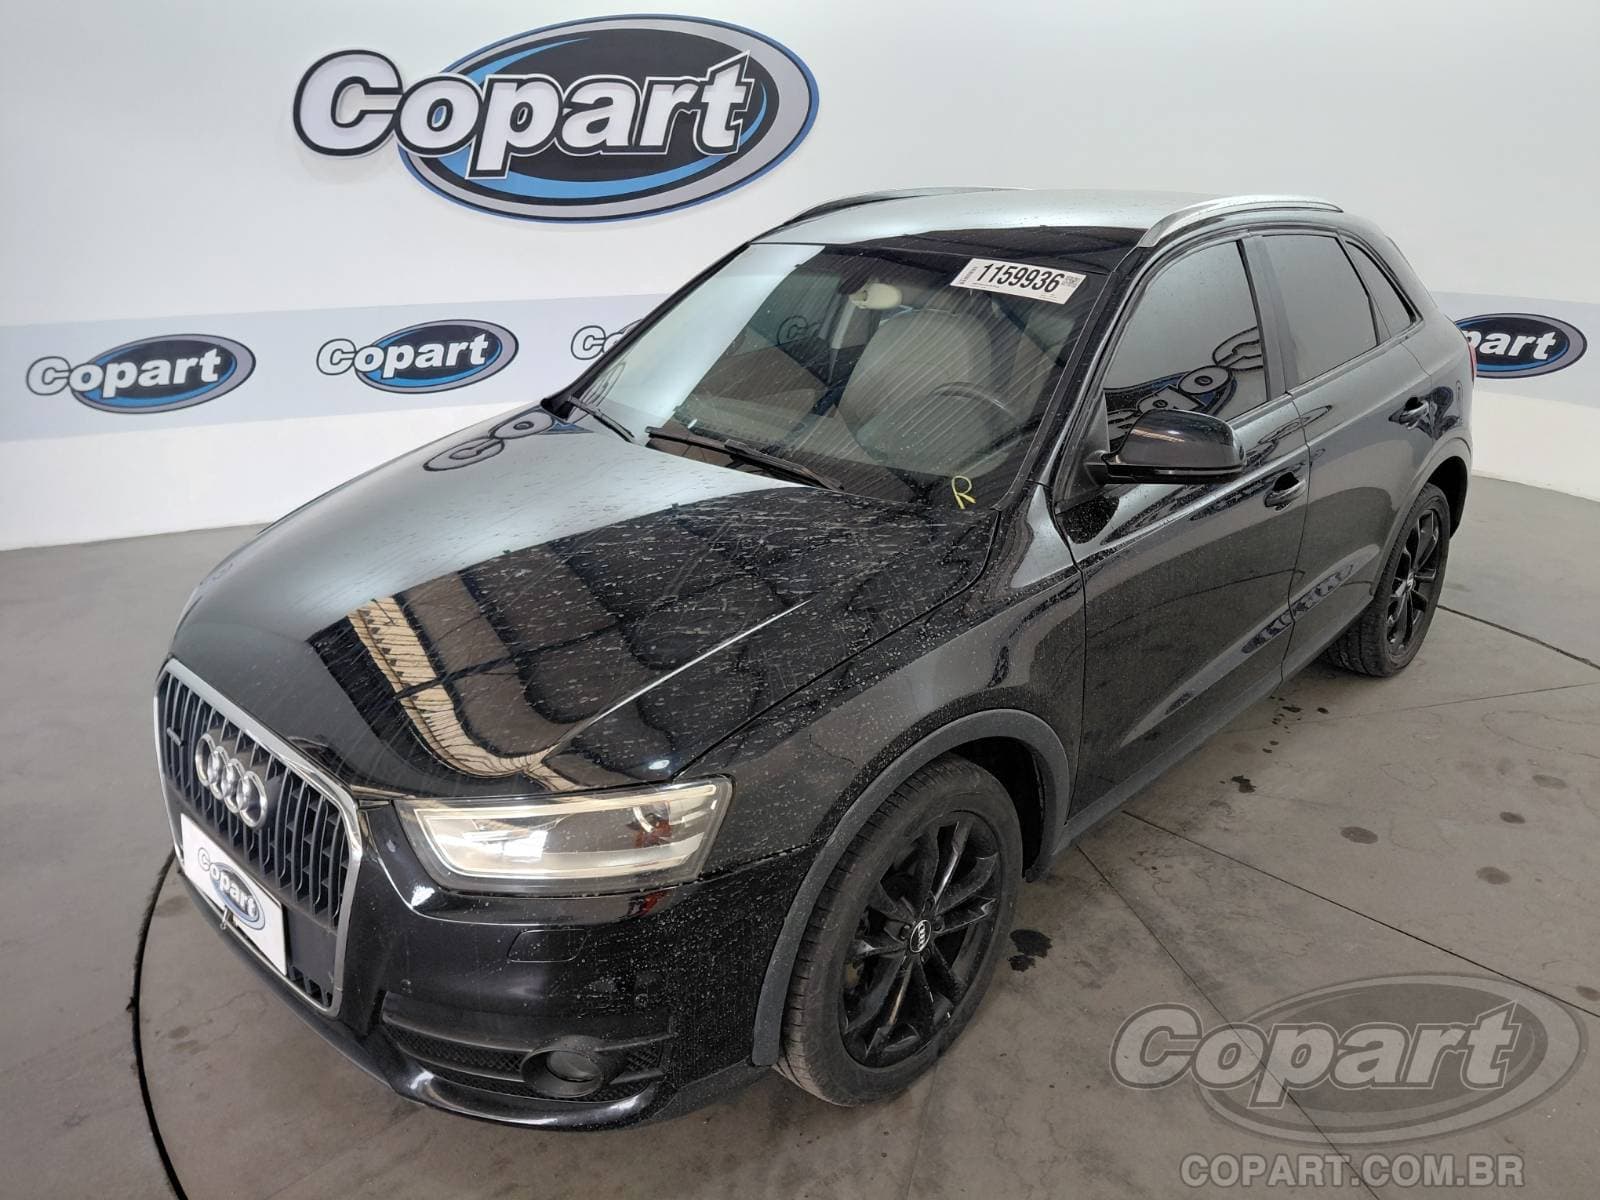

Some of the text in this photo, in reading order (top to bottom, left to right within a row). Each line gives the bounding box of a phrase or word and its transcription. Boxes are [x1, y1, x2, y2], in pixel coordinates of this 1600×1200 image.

[293, 49, 755, 179] Copart
[976, 263, 1066, 294] 1159936
[26, 348, 222, 399] Copart
[316, 333, 489, 379] Copart
[951, 475, 977, 510] R
[197, 847, 257, 919] Copart
